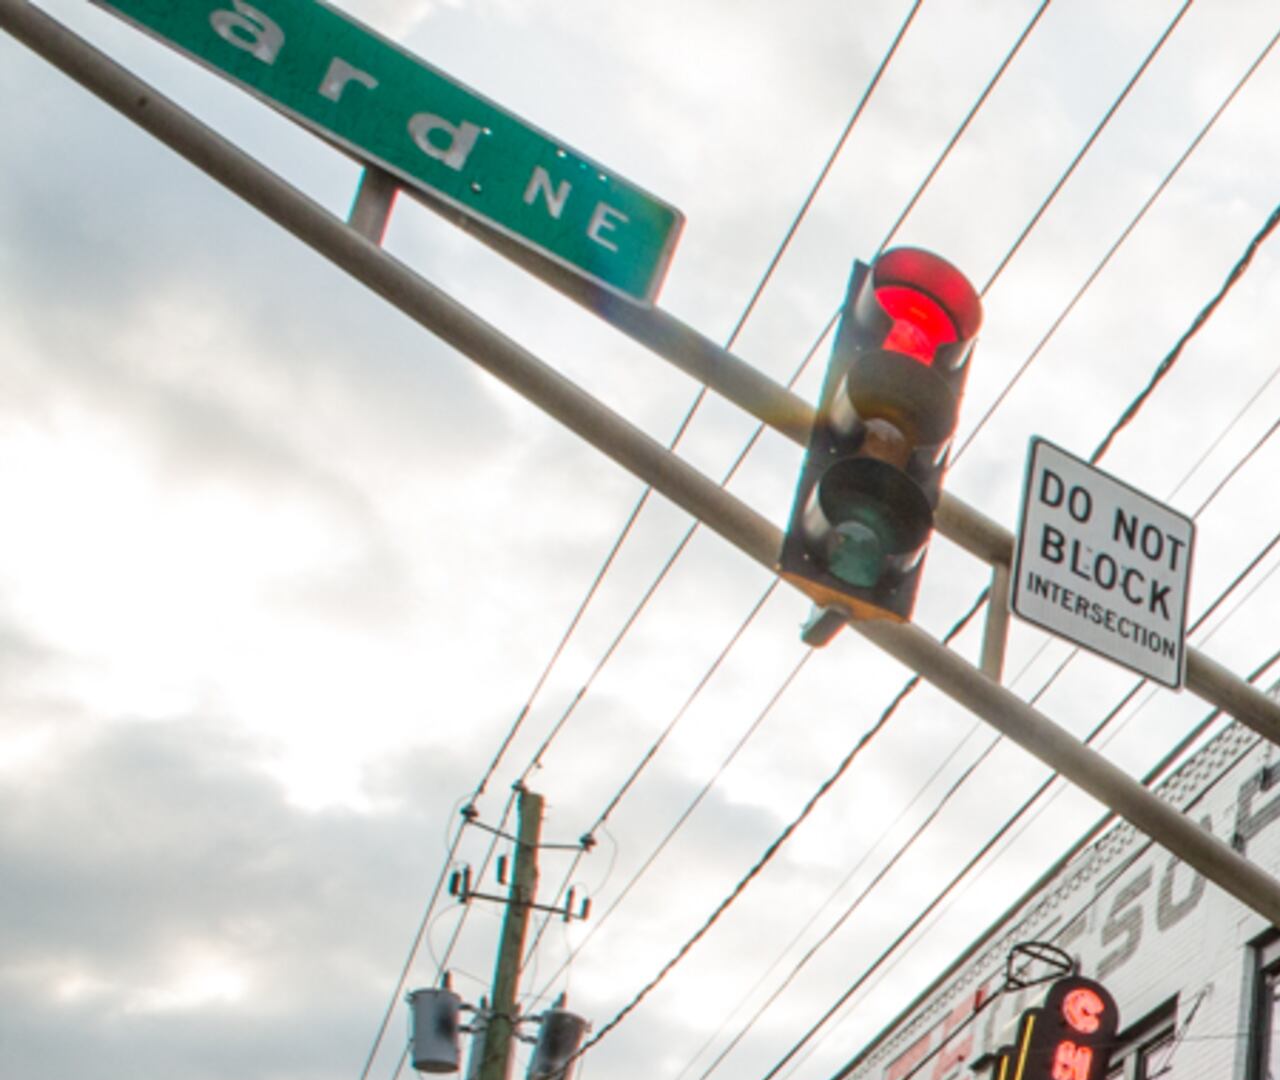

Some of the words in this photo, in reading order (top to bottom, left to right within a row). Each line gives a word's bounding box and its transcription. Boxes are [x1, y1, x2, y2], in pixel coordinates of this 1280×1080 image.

[523, 166, 629, 253] NE
[1040, 467, 1092, 523] DO
[1113, 506, 1186, 573] NOT
[1026, 572, 1176, 659] INTERSECTION
[1040, 522, 1171, 621] BLOCK
